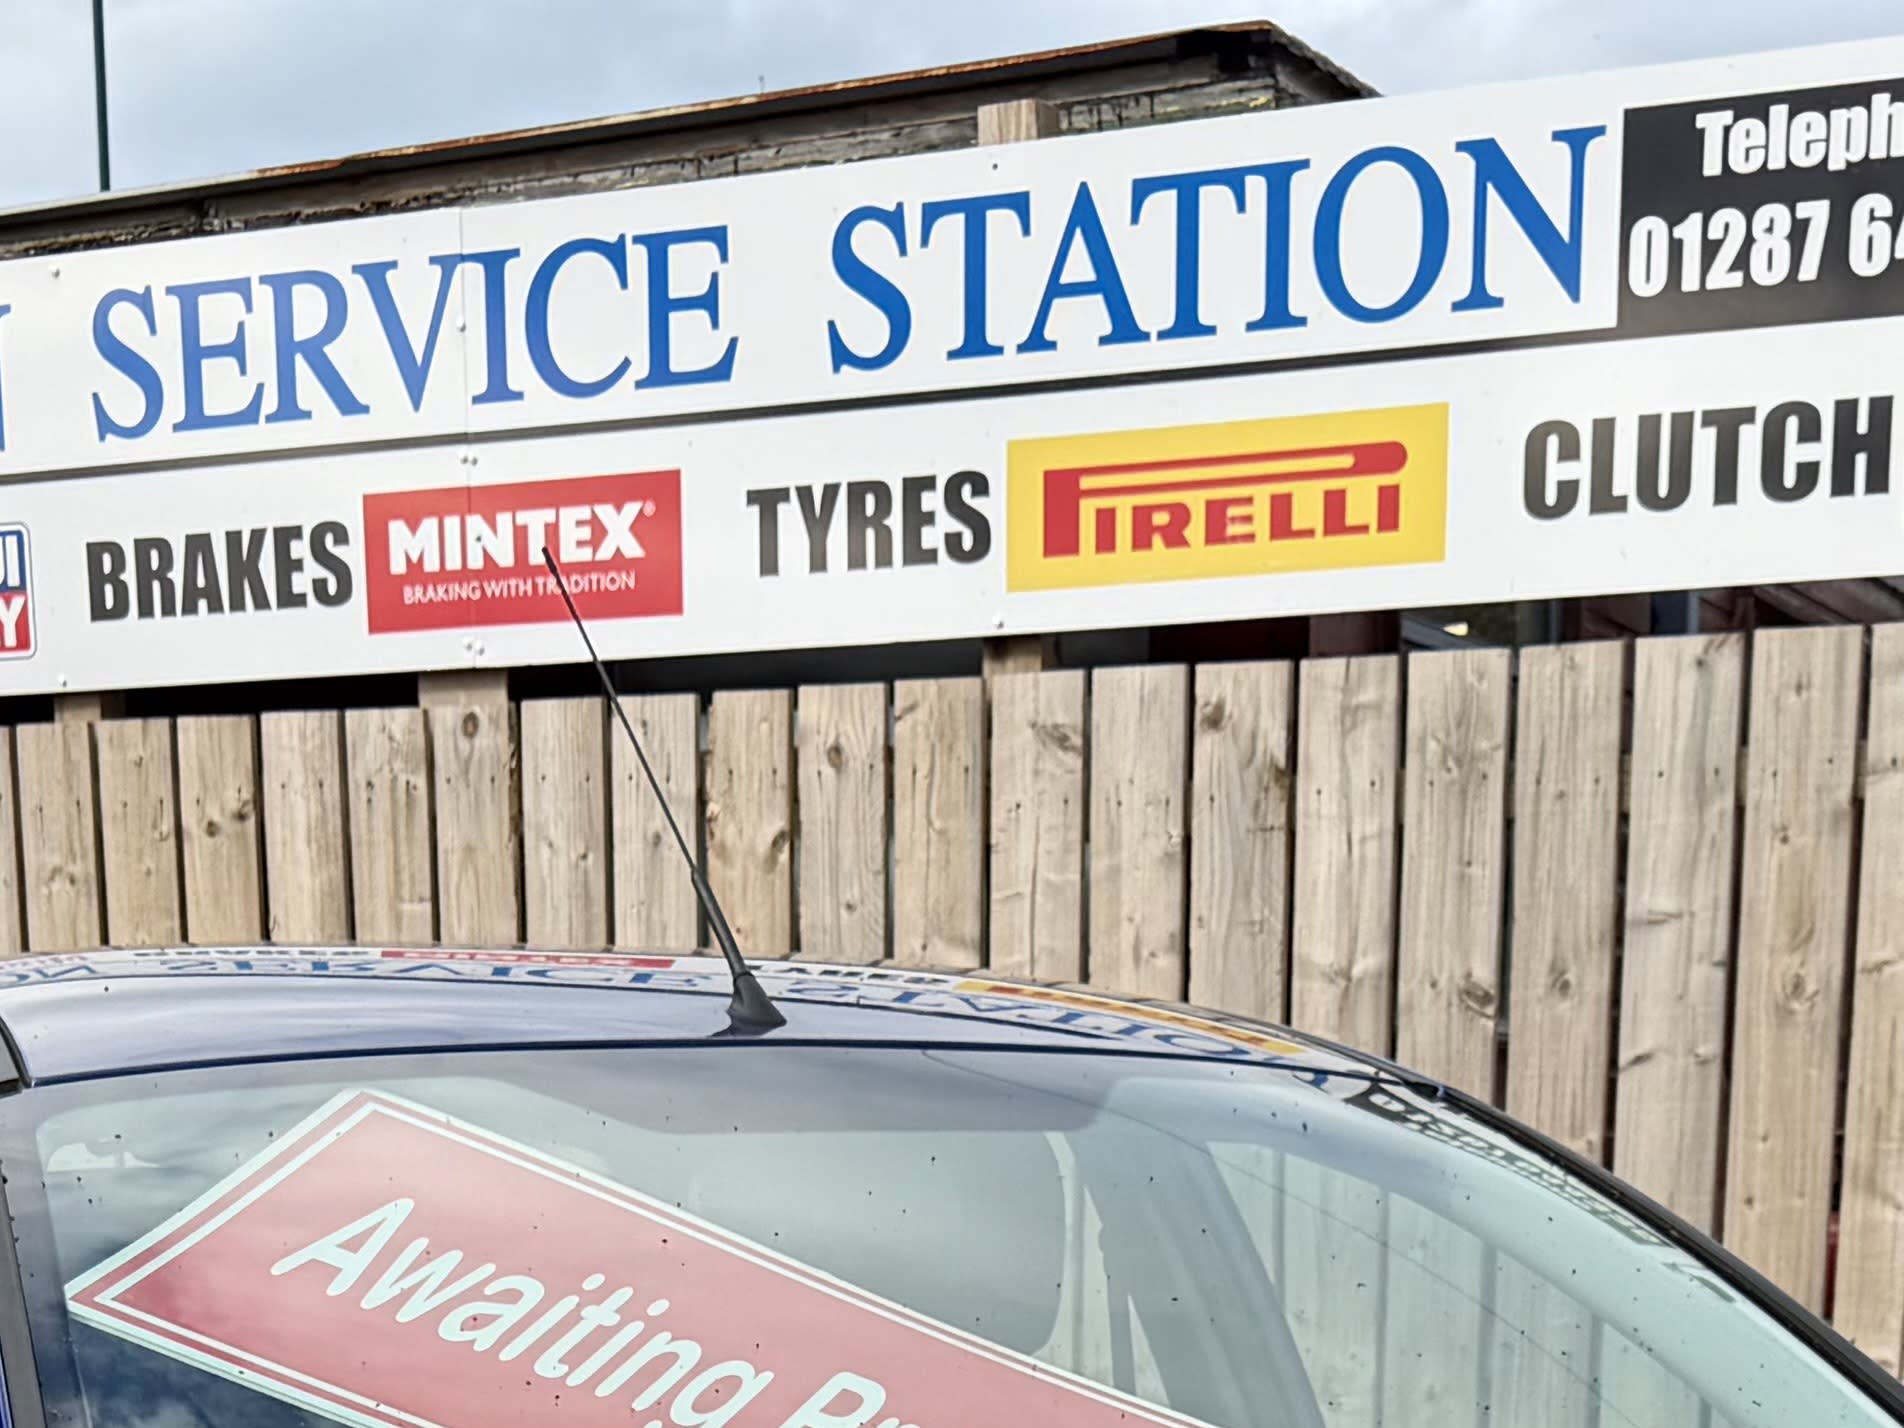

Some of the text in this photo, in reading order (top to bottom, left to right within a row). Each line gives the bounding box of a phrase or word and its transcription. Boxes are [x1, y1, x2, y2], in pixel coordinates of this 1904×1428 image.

[94, 226, 736, 440] SERVICE
[829, 127, 1606, 373] STATION
[1629, 200, 1829, 296] 01287
[1044, 442, 1407, 557] PIRELLI
[1525, 398, 1891, 518] CLUTCH
[87, 522, 352, 621] BRAKES
[388, 501, 645, 575] MINTEX
[747, 471, 990, 575] TYRES
[403, 577, 482, 605] BRAKING
[483, 576, 530, 599] WITH
